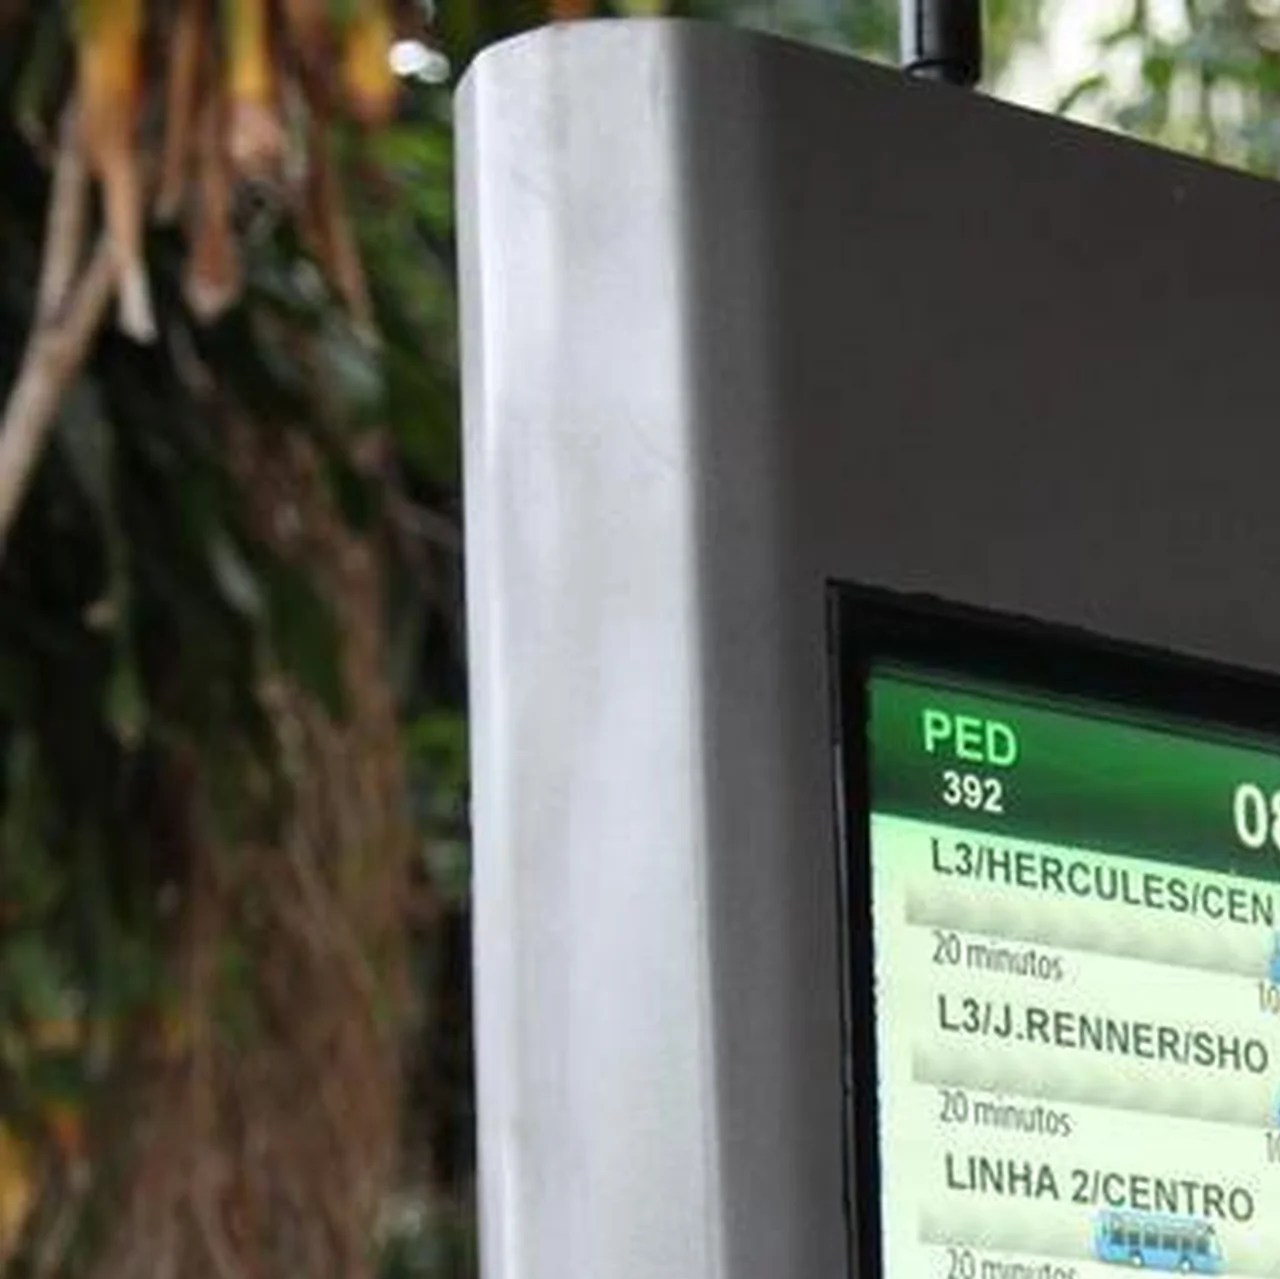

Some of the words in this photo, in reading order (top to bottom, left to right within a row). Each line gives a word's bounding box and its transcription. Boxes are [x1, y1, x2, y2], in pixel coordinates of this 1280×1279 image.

[922, 709, 1018, 766] PED
[943, 771, 1004, 813] 392
[931, 837, 1276, 928] L3/HERCULES/CEN
[932, 931, 961, 967] 20
[967, 938, 1065, 982] minutos
[1257, 981, 1280, 1015] 10
[938, 995, 1269, 1074] L3/J.RENNER/SHO
[938, 1091, 969, 1124] 20
[974, 1096, 1072, 1138] minutos
[945, 1152, 1060, 1201] LINHA
[1071, 1168, 1255, 1223] 2/CENTRO
